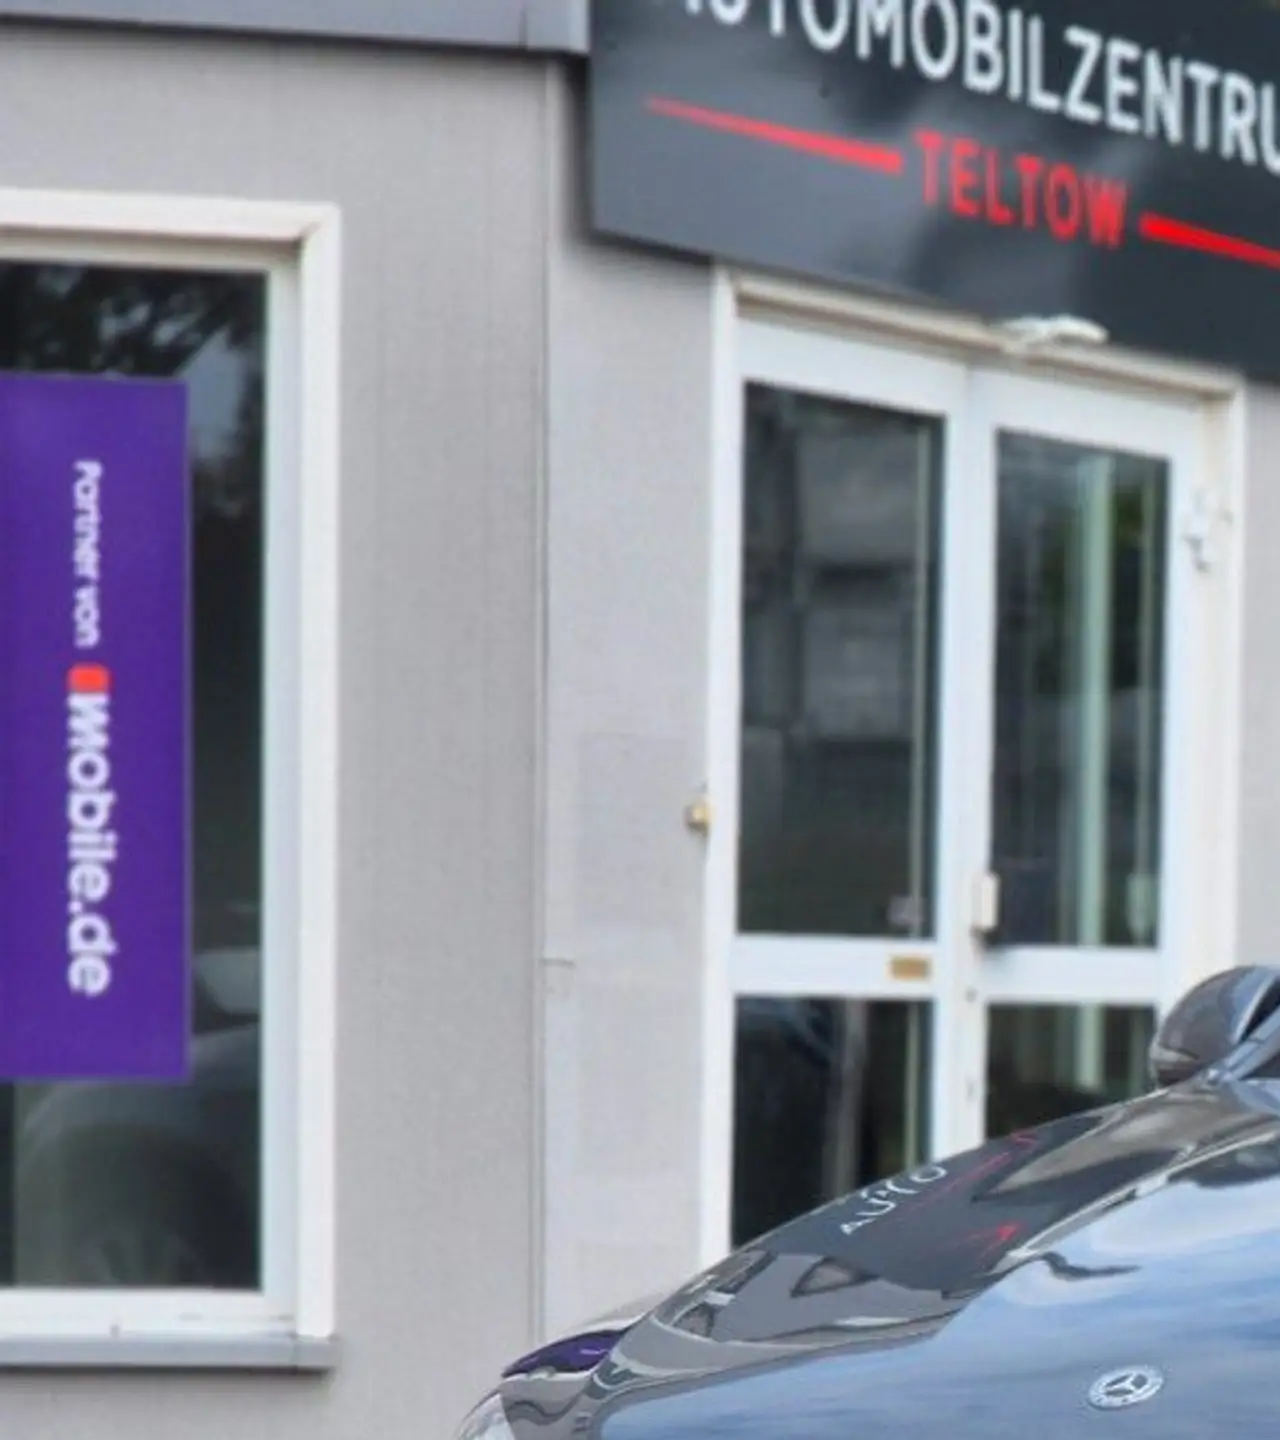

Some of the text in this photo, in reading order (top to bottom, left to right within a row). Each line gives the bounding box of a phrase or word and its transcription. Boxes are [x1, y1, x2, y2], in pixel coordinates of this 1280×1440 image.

[916, 130, 1128, 247] TELTOW
[67, 460, 118, 997] Partner von mobile.de
